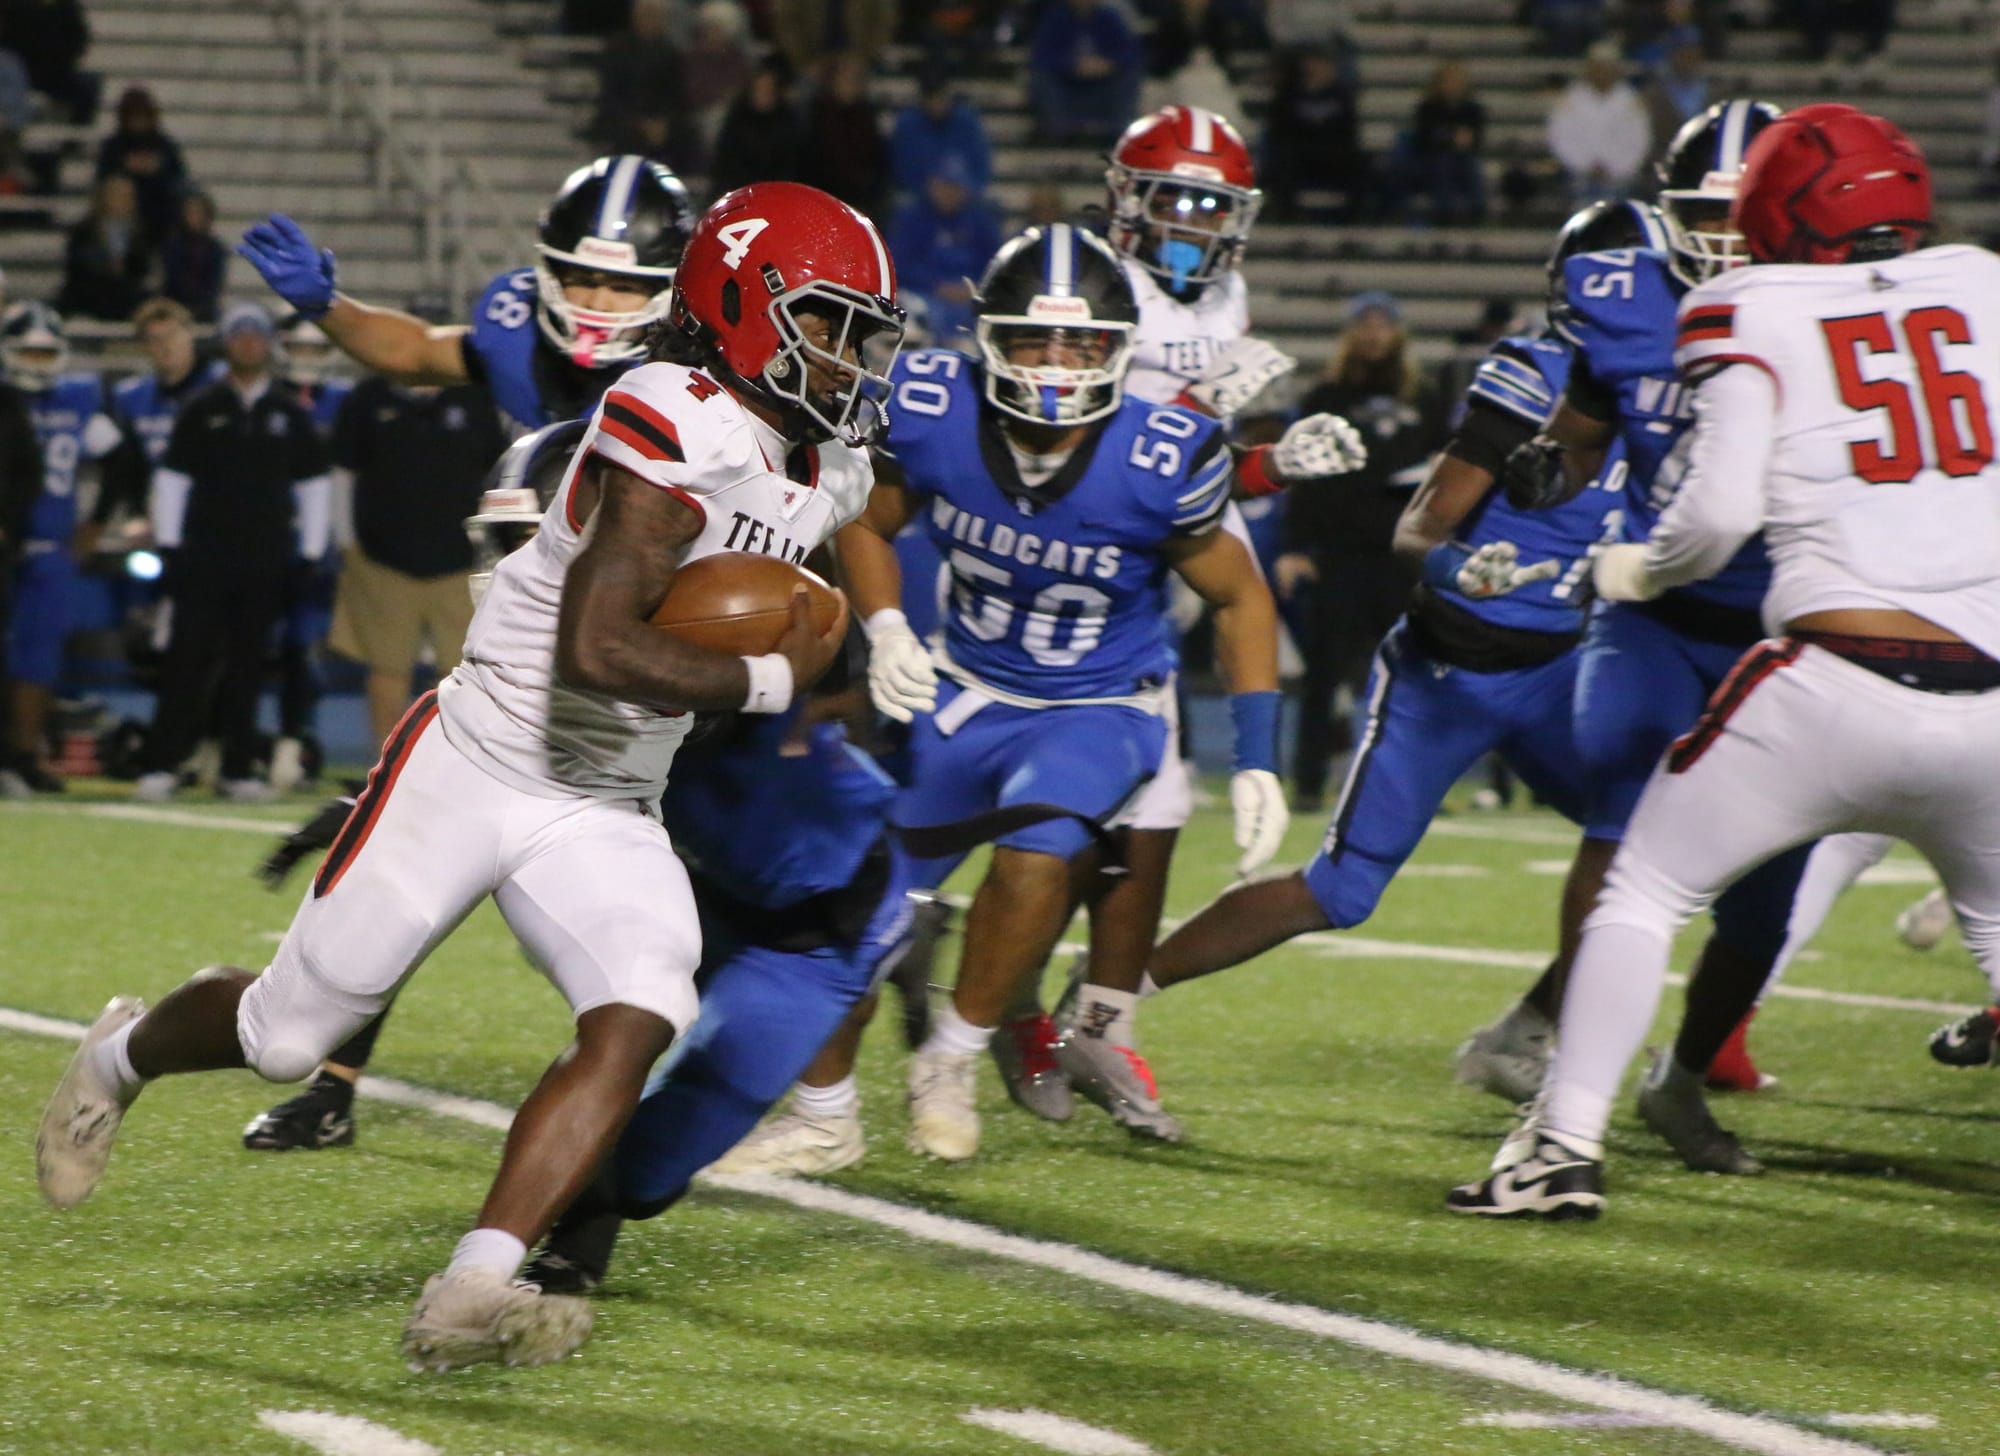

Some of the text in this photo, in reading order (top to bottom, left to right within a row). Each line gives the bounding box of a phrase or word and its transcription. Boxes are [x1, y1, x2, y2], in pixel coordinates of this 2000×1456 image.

[716, 218, 769, 270] 4
[897, 353, 960, 416] 50
[1819, 304, 1994, 484] 56
[1130, 410, 1198, 477] 50
[932, 495, 1122, 579] WILDCATS
[951, 548, 1112, 666] 50
